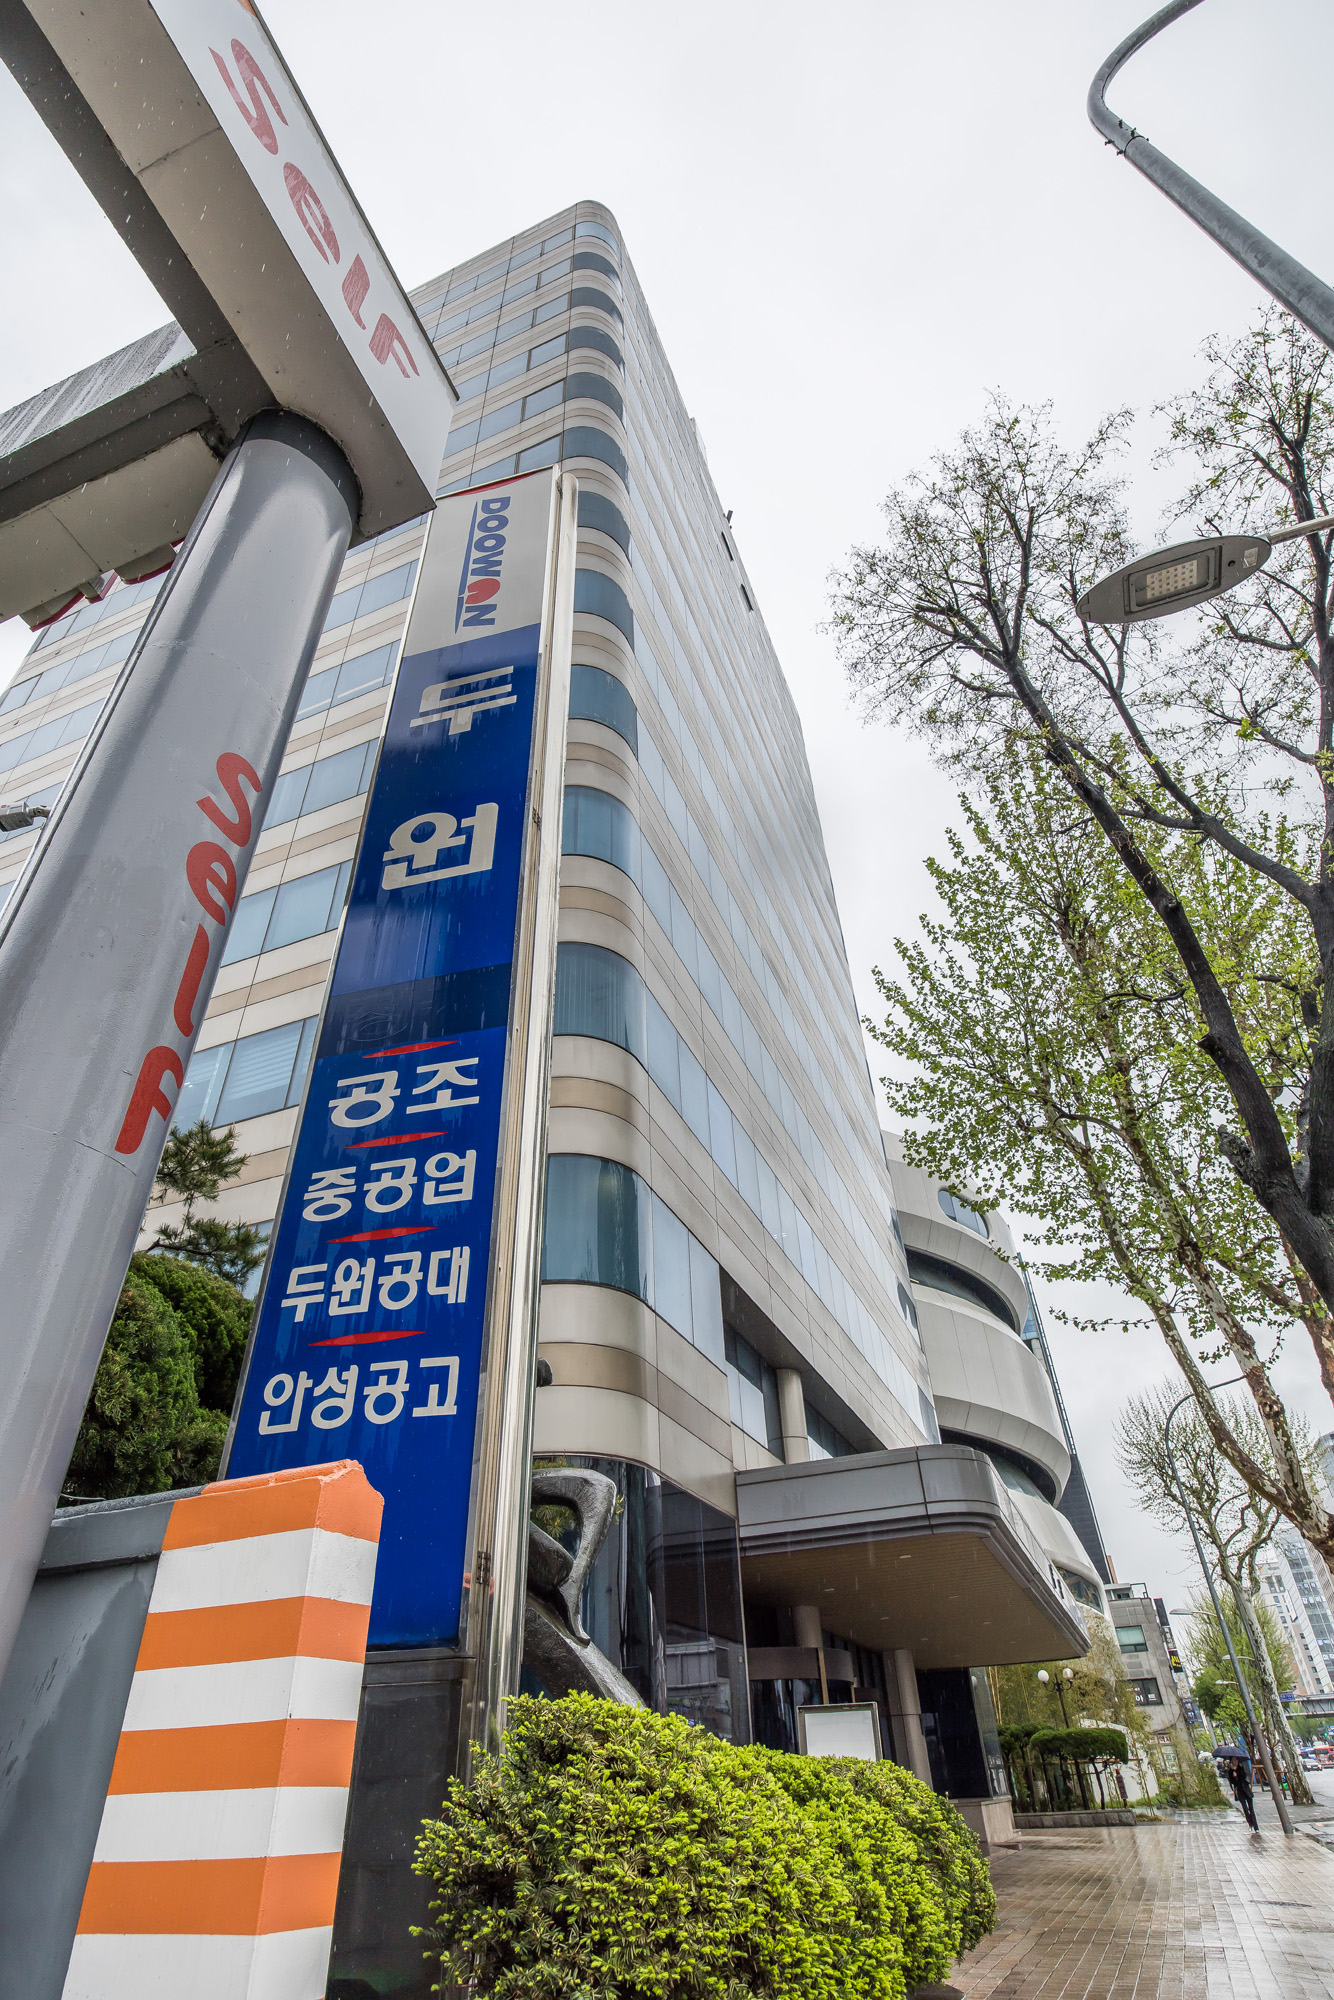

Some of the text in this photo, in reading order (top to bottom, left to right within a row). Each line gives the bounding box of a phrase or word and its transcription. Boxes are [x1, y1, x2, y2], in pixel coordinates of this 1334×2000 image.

[328, 1057, 480, 1128] 공조
[302, 1150, 477, 1222] 중공업
[281, 1245, 470, 1323] 두원공대
[258, 1355, 460, 1436] 안성공고
